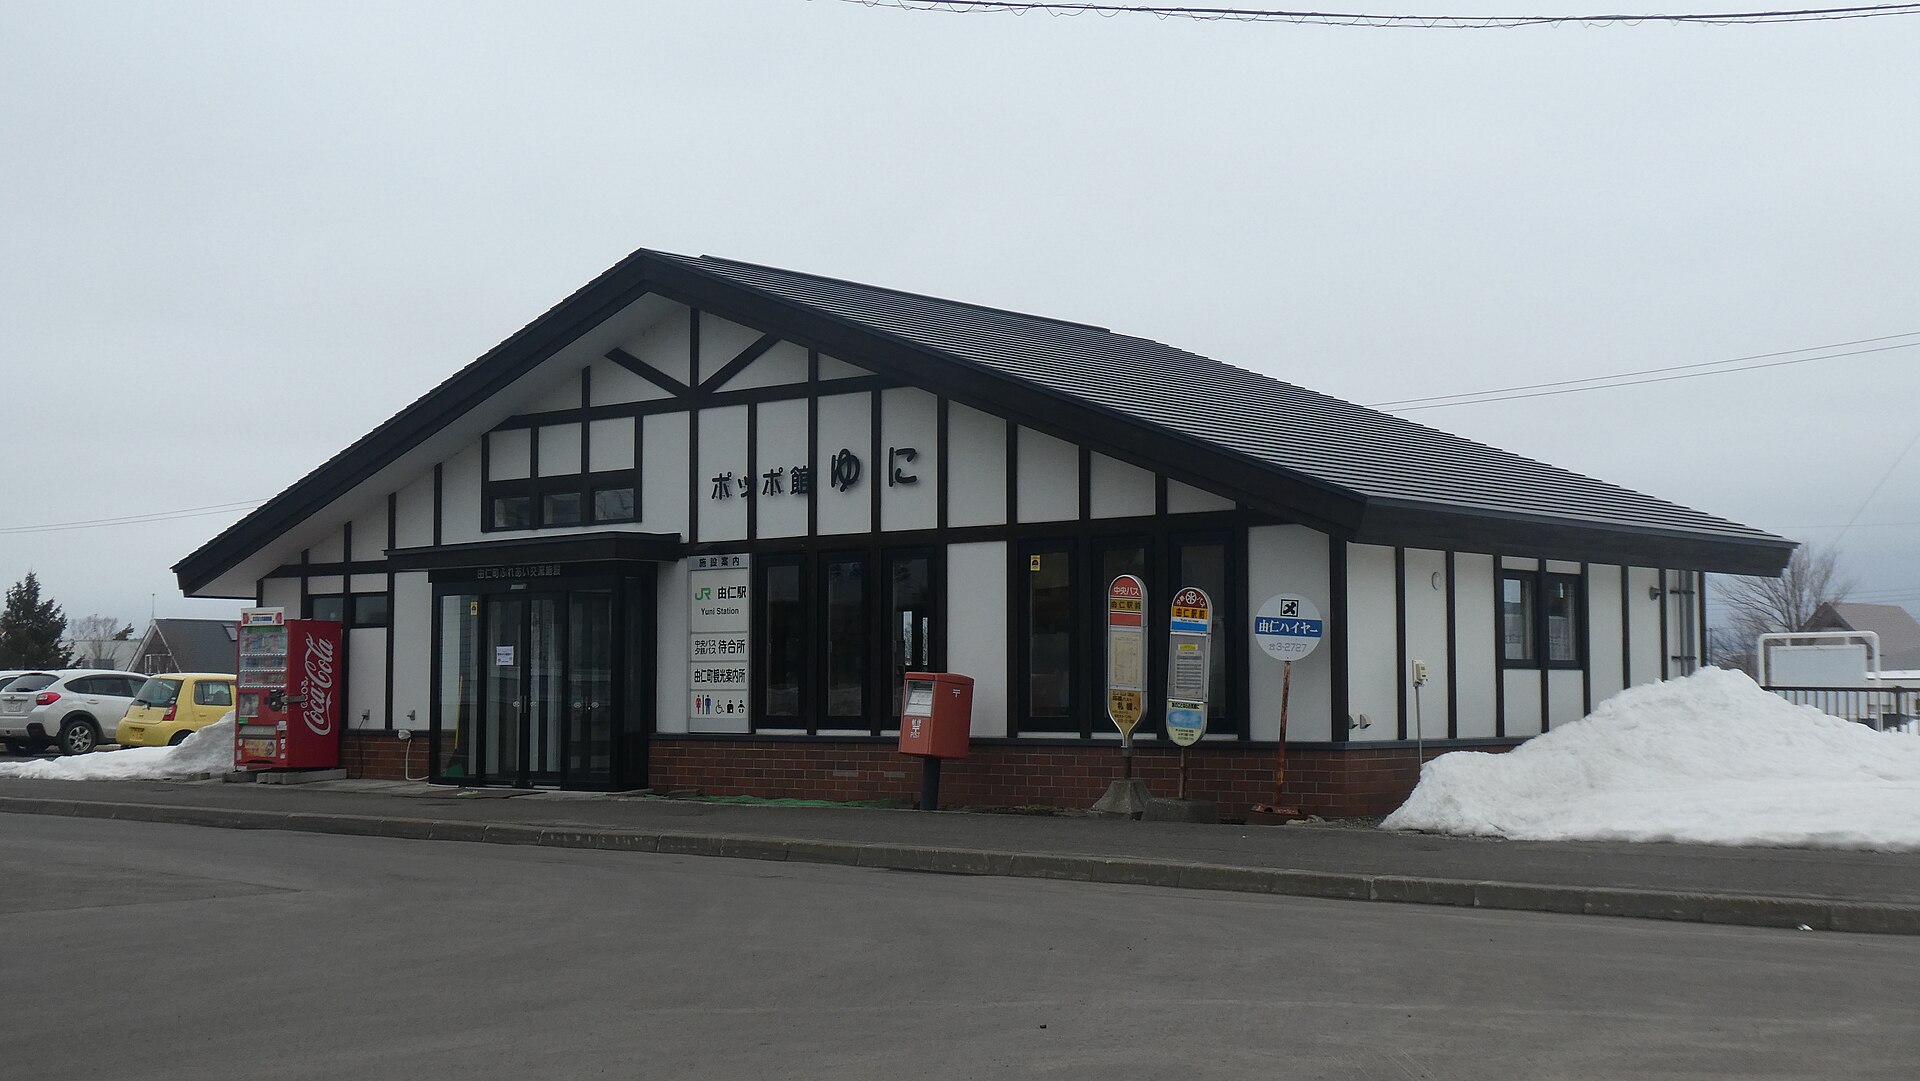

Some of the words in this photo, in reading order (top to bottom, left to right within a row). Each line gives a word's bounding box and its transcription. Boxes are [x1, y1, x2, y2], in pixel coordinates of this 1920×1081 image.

[831, 447, 917, 493] ゆに
[699, 555, 740, 568] 施設案内
[695, 587, 711, 600] JR
[717, 586, 747, 600] 由仁駅
[1113, 586, 1140, 596] 中央バス
[701, 607, 715, 616] Yuni
[717, 606, 740, 615] Station
[1259, 619, 1319, 635] 由仁ハイヤー
[718, 639, 746, 654] 待合所
[694, 668, 746, 684] 由仁町観光案内所
